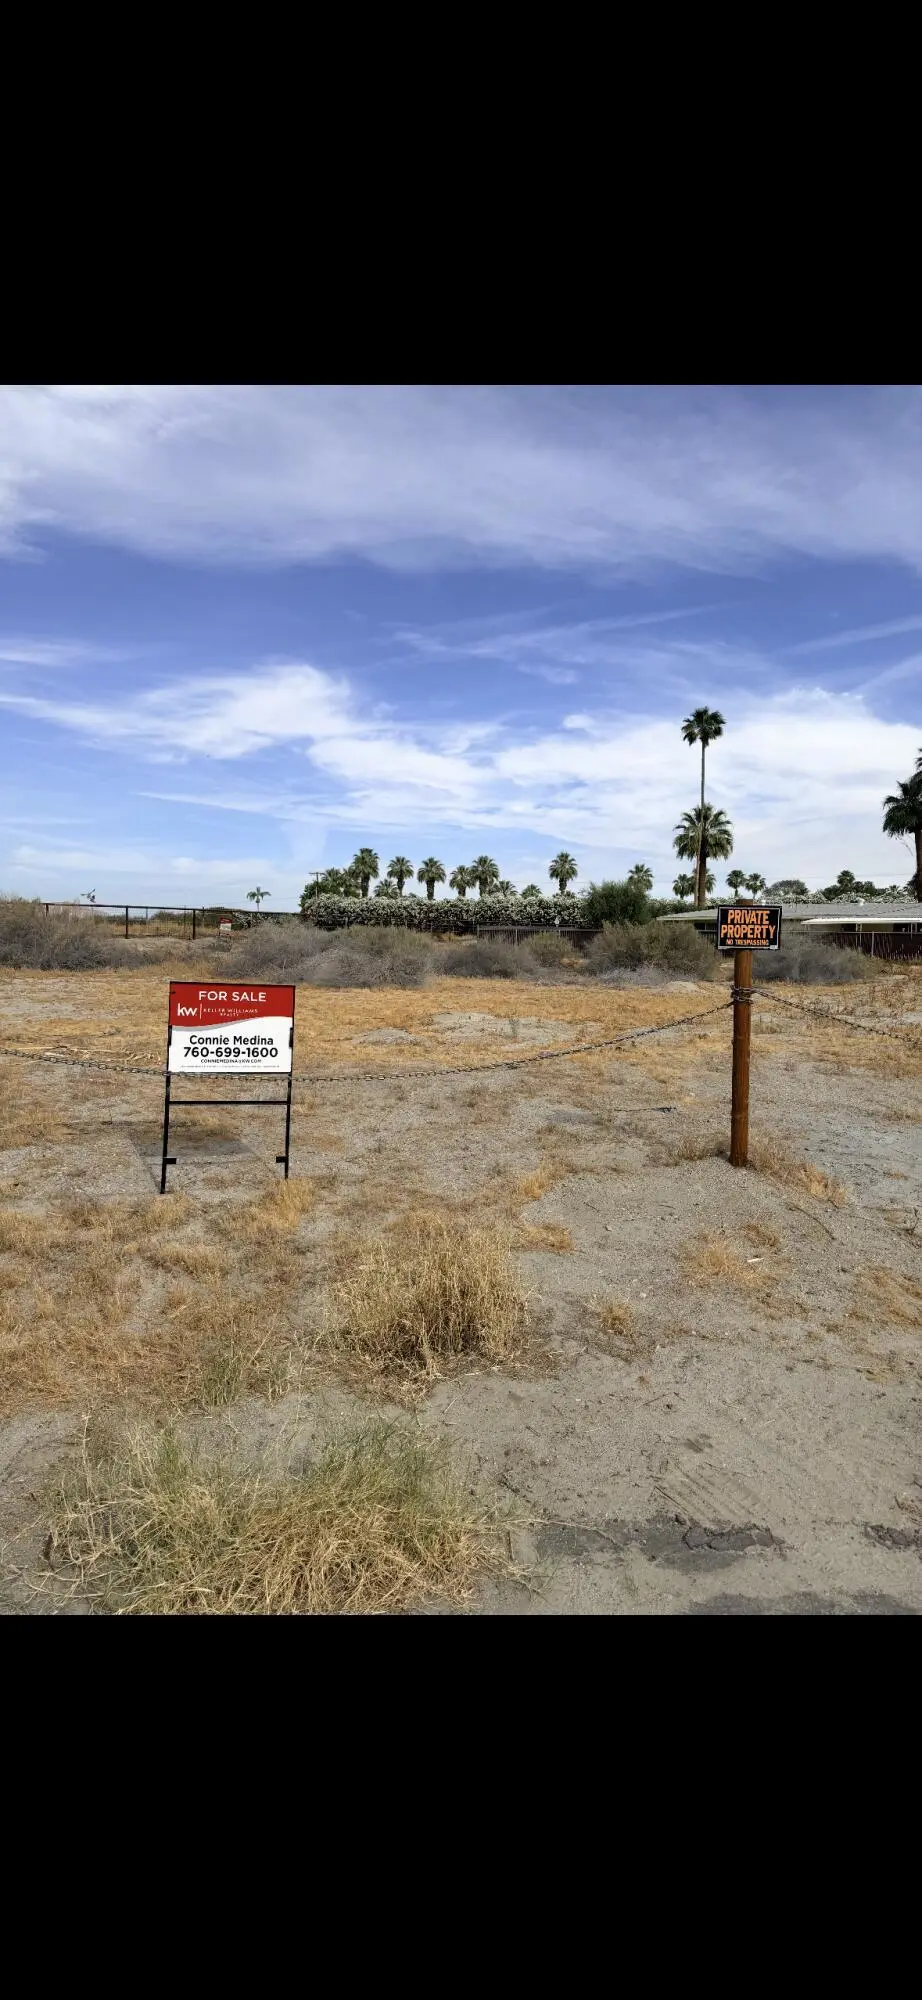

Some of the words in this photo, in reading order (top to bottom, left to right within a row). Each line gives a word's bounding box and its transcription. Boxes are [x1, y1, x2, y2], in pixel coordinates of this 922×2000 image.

[727, 909, 770, 925] PRIVATE
[720, 924, 776, 939] PROPERTY
[198, 990, 228, 1001] FOR
[232, 991, 267, 1002] SALE
[177, 1002, 198, 1017] kw
[189, 1034, 230, 1046] Connie
[233, 1035, 274, 1046] Medina
[183, 1046, 279, 1058] 760-699-1600
